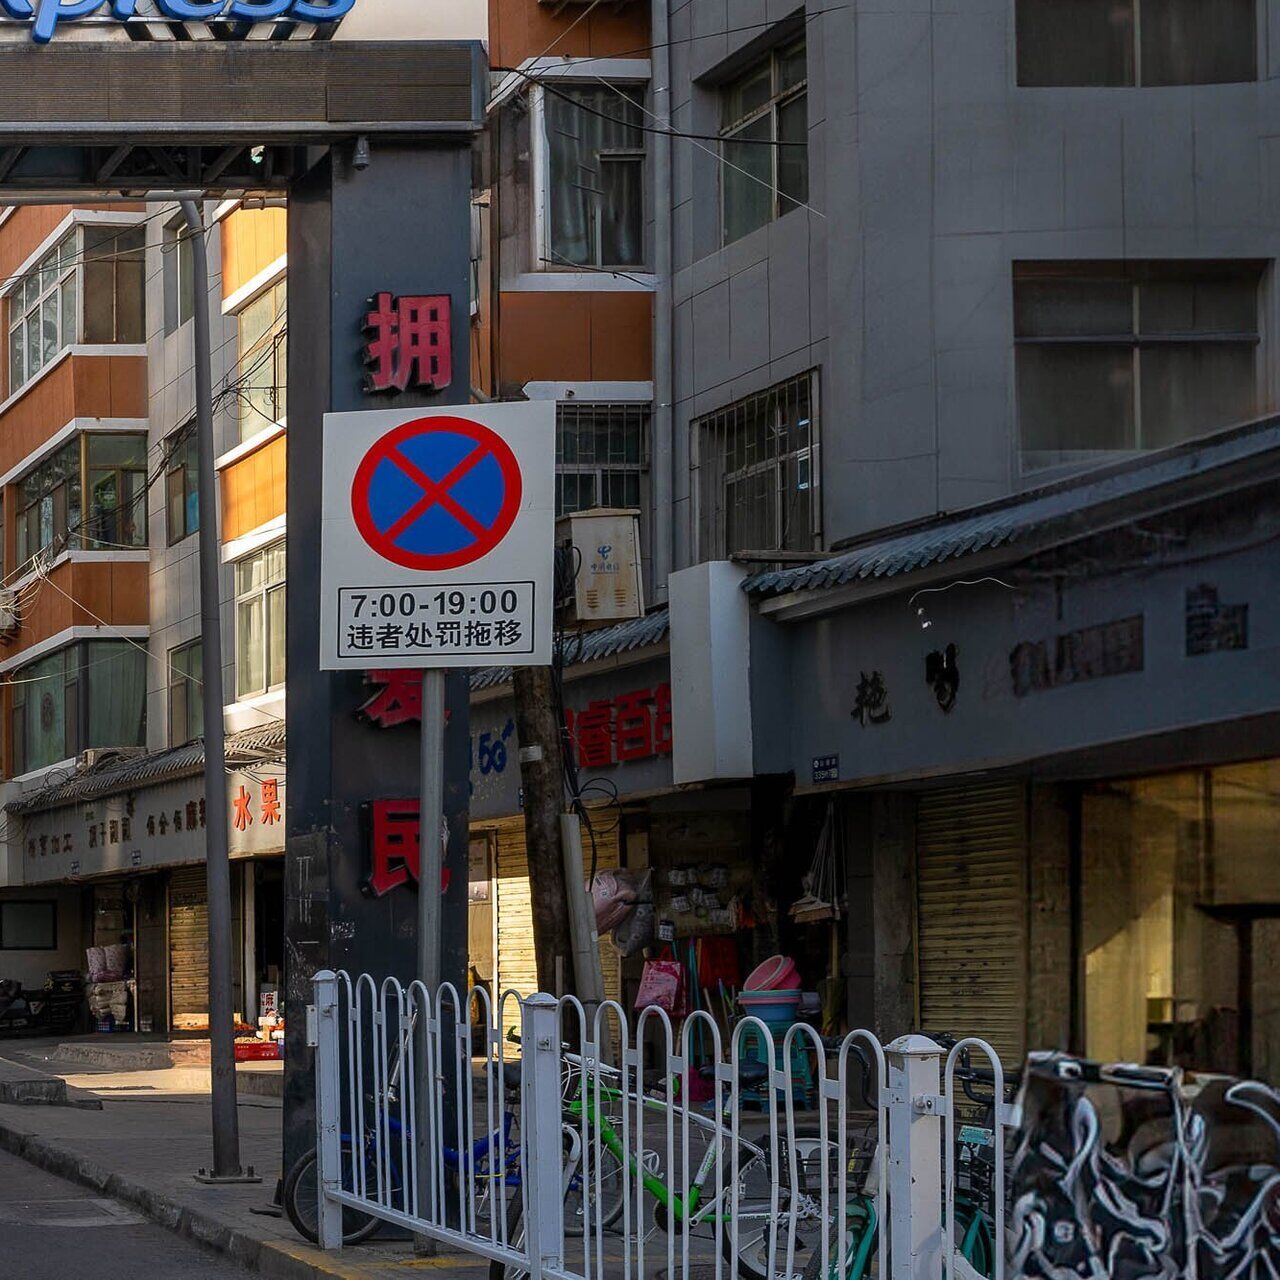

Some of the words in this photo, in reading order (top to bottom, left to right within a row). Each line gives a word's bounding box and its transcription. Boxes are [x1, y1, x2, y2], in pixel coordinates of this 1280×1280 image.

[351, 589, 517, 618] 7:00-19:00
[347, 619, 522, 650] 违者处罚拖移
[233, 778, 280, 831] 水果
